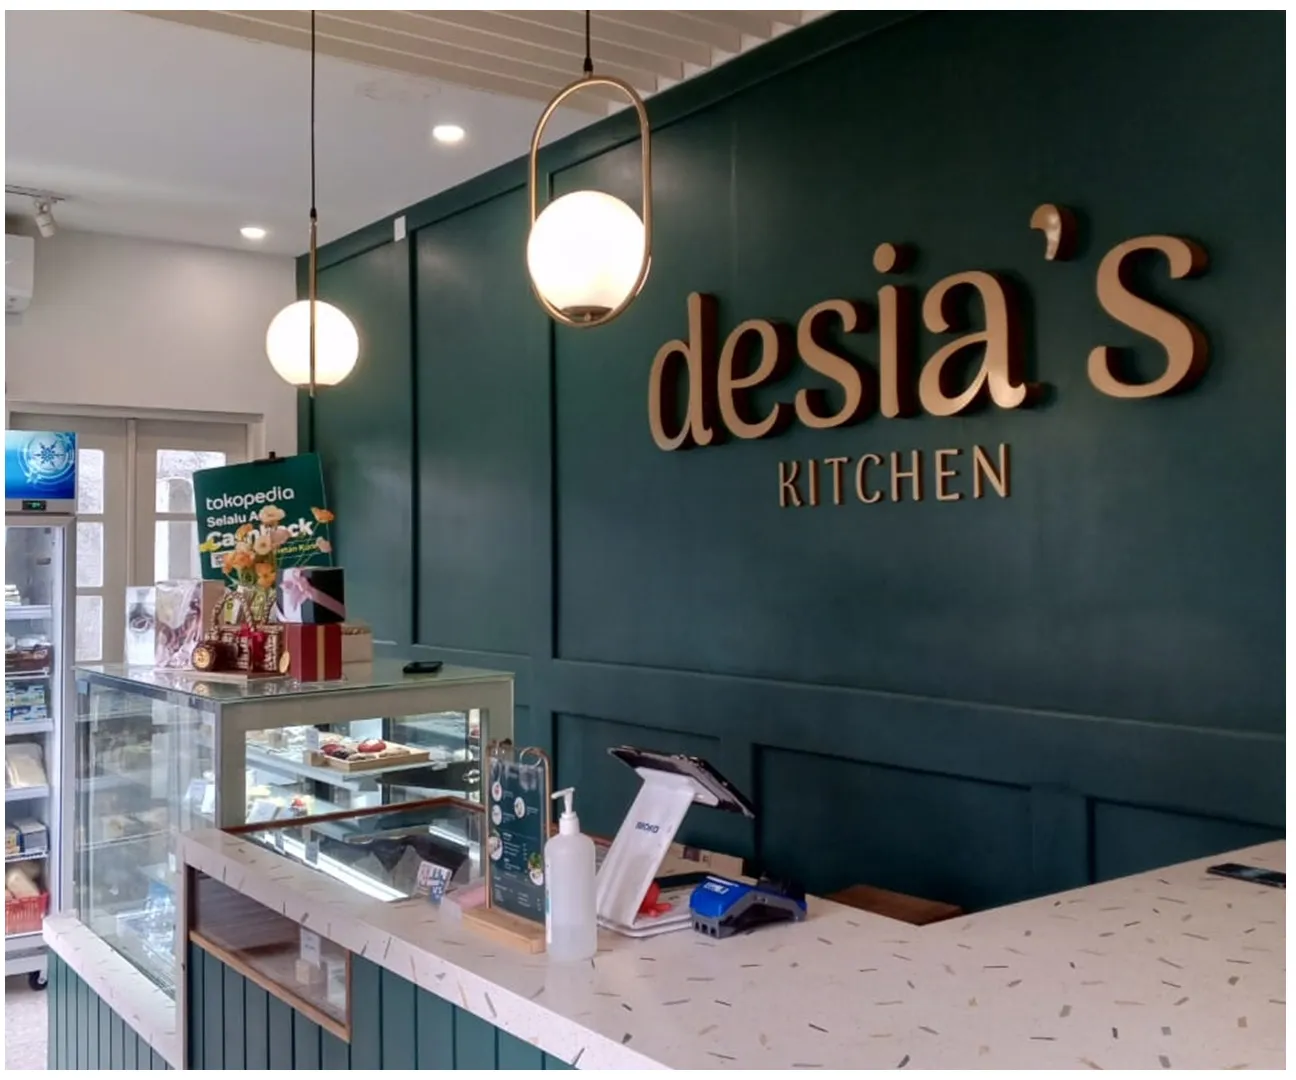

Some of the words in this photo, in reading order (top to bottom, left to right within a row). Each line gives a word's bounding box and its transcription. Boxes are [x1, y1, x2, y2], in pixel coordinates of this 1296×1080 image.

[648, 203, 1206, 450] desia's
[778, 443, 1011, 507] KITCHEN
[206, 486, 295, 511] tokopedia
[206, 512, 247, 528] Selalu
